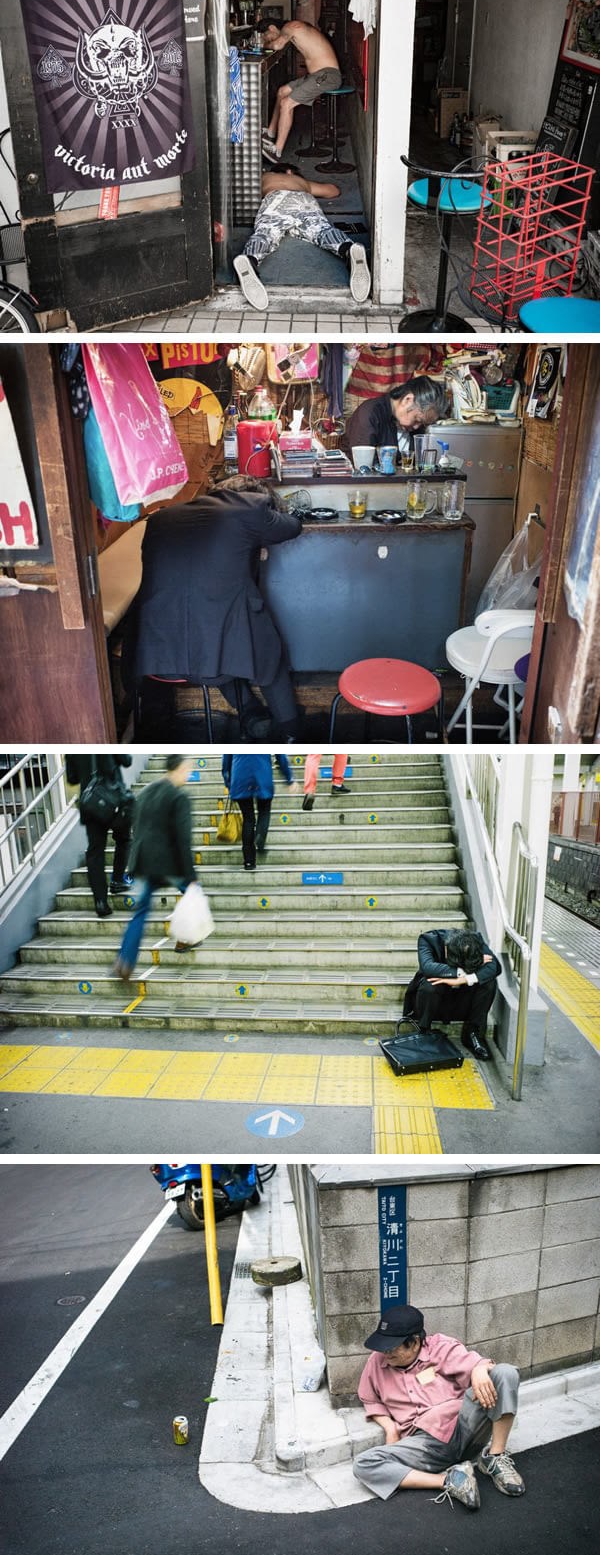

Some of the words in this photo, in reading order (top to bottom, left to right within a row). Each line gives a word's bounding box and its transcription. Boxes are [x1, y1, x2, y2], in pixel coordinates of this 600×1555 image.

[111, 119, 137, 130] XXXX
[54, 143, 116, 181] victoria
[0, 501, 35, 546] H
[386, 1222, 401, 1298] 清川二丁目
